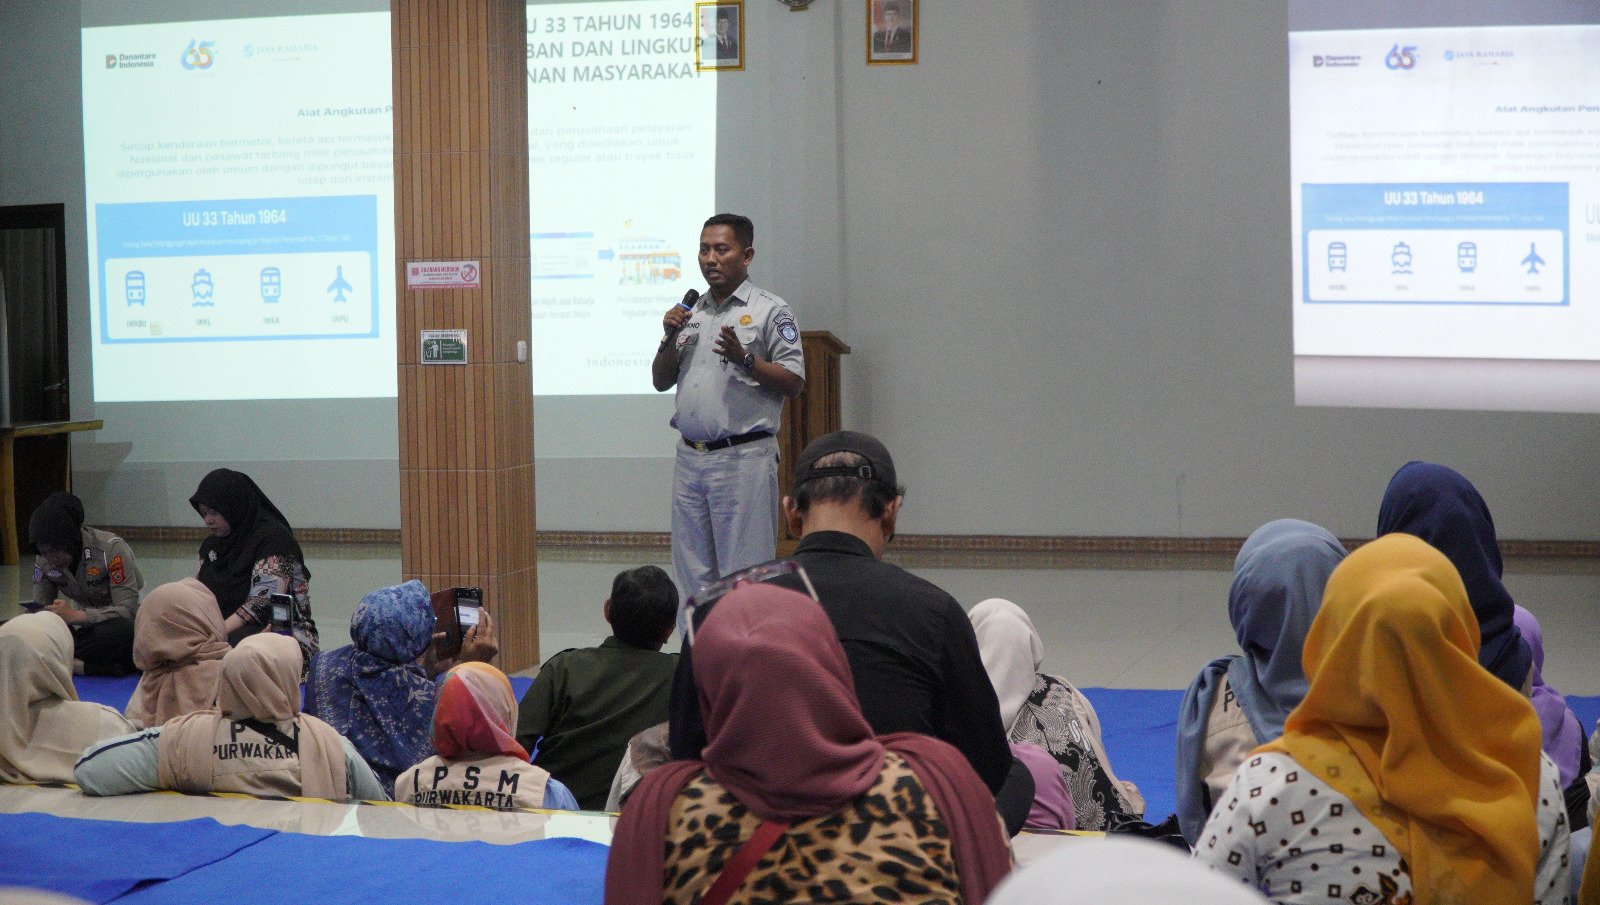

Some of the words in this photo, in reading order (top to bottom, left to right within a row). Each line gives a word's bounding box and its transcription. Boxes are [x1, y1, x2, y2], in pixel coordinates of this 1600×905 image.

[545, 17, 566, 33] 33
[573, 14, 641, 32] TAHUN
[651, 12, 693, 29] 1964
[119, 52, 156, 61] Danantara
[527, 42, 563, 59] BAN
[572, 40, 613, 57] DAN
[622, 37, 704, 56] LINGKUP
[1385, 43, 1418, 70] 65
[119, 60, 154, 69] Indonesia
[528, 67, 566, 84] NAN
[573, 61, 703, 83] MASYARAKAT
[297, 108, 321, 118] Alat
[323, 106, 382, 118] Angkutan
[1578, 105, 1600, 113] Pen
[1384, 191, 1403, 206] UU
[1403, 191, 1419, 206] 33
[1420, 190, 1455, 206] Tahun
[182, 212, 201, 227] UU
[202, 211, 218, 226] 33
[220, 209, 256, 226] Tahun
[258, 207, 287, 224] 1964
[213, 742, 294, 760] URWAKAR
